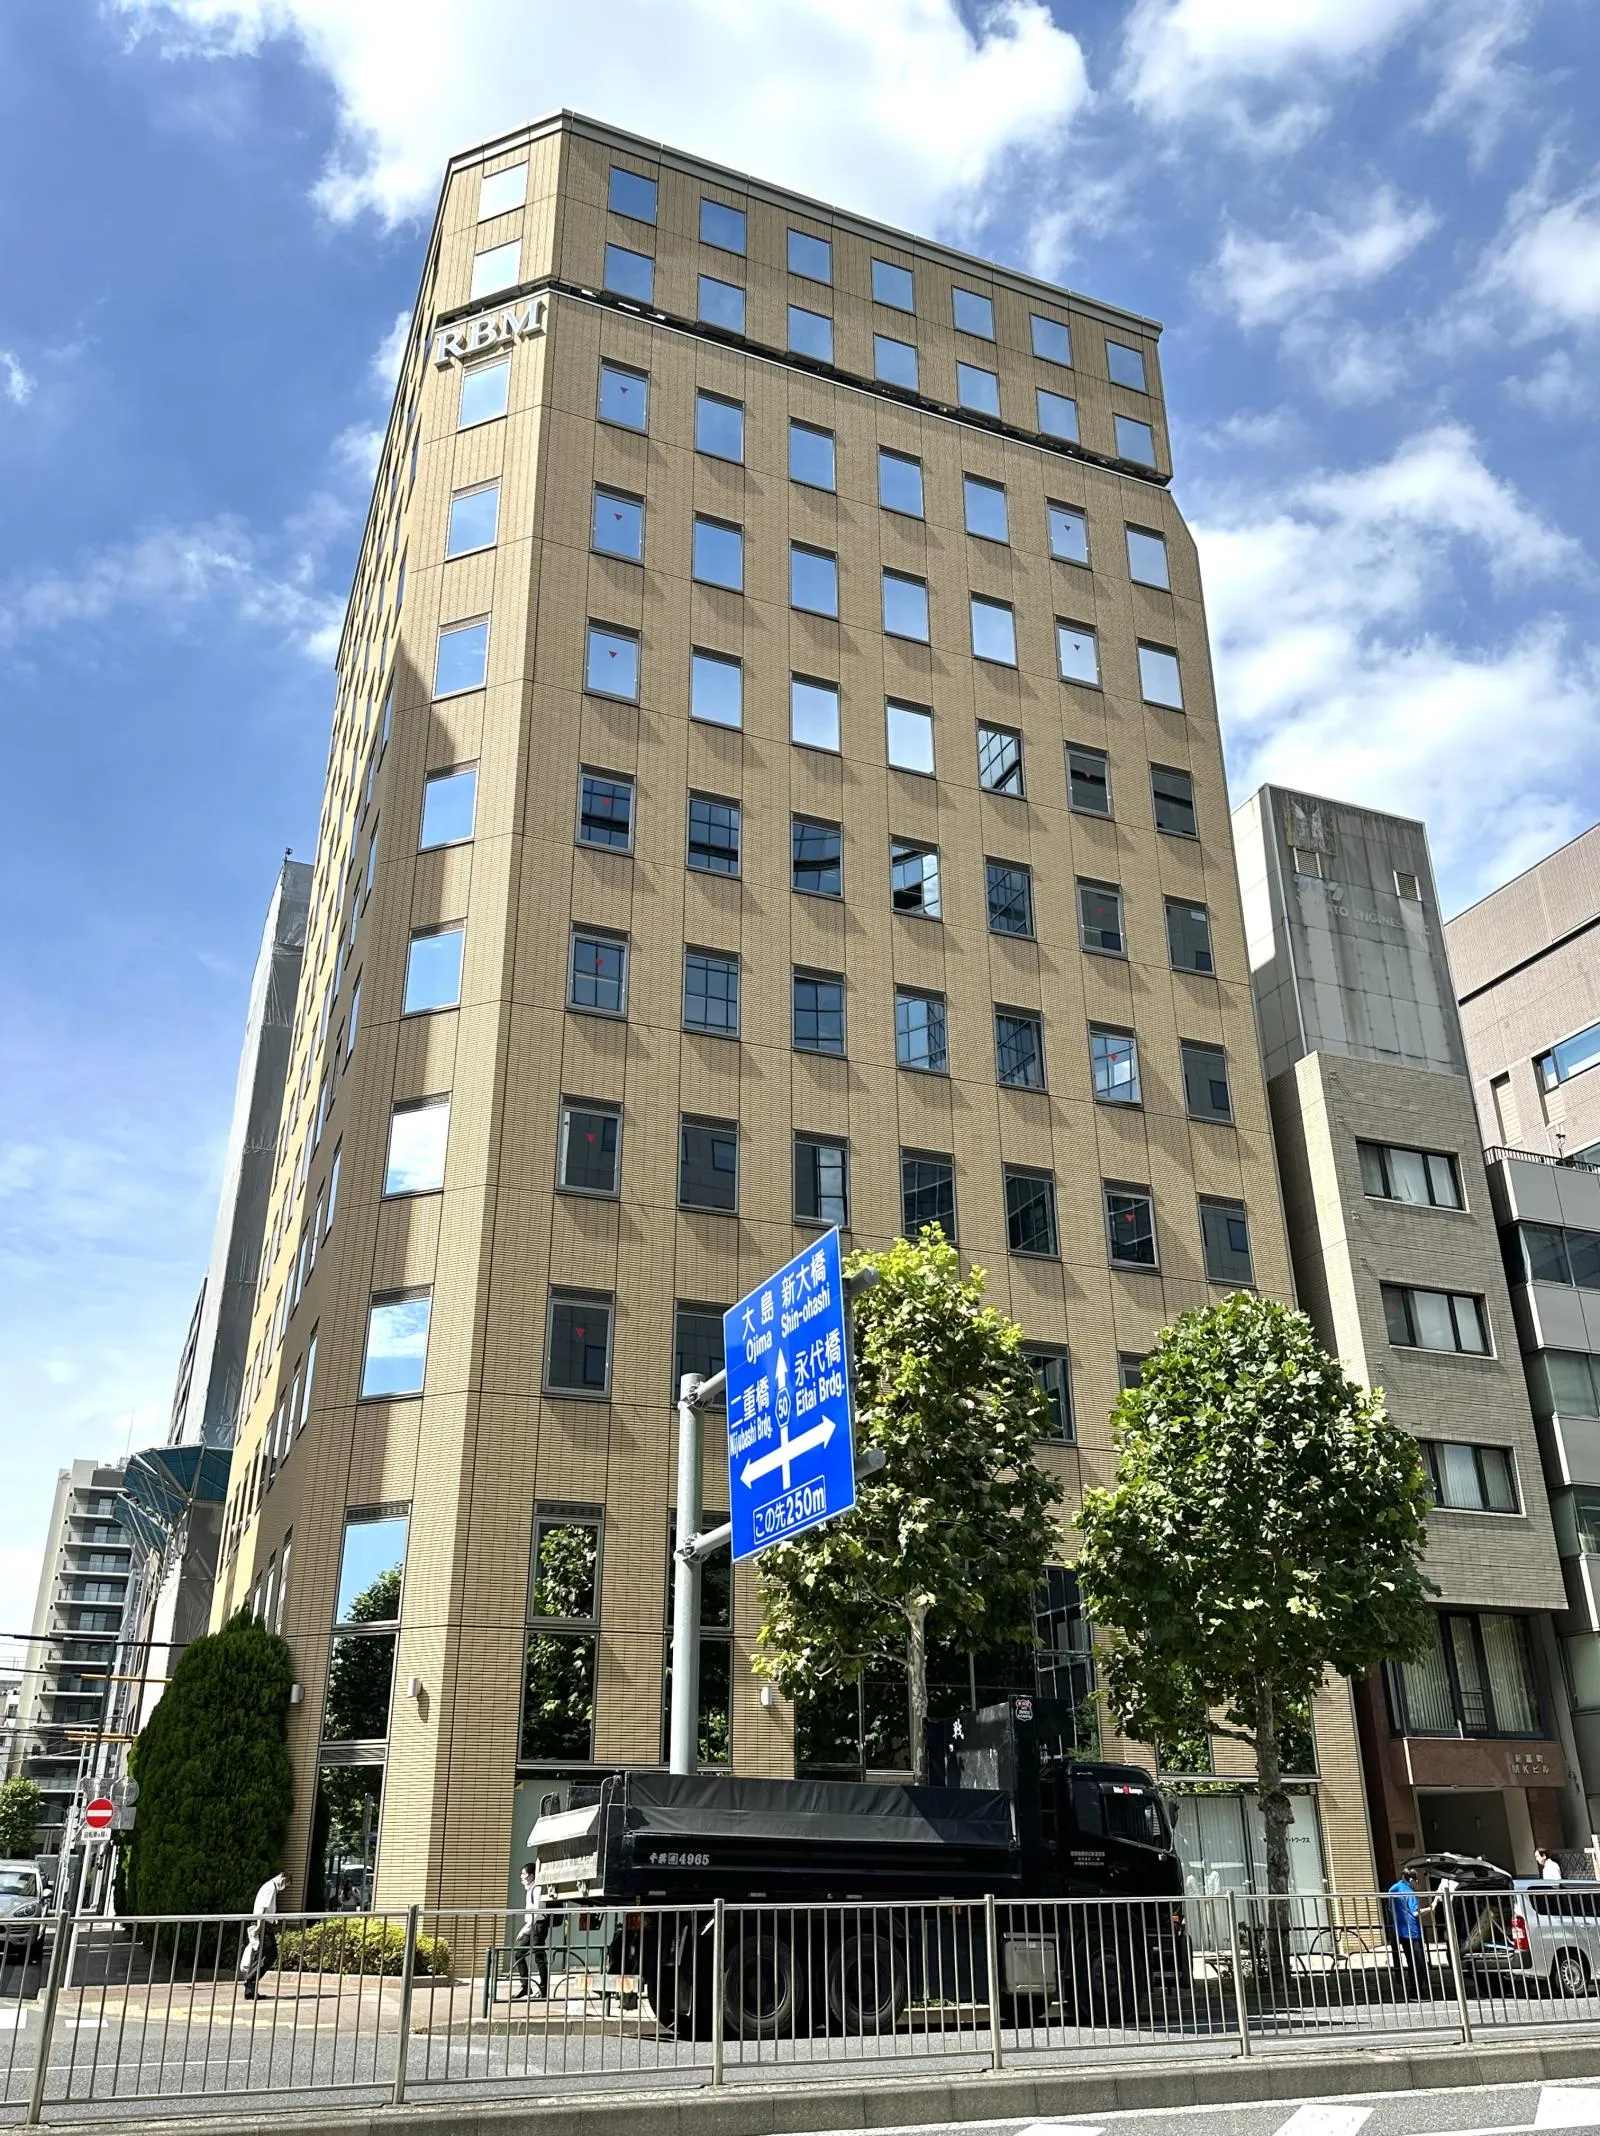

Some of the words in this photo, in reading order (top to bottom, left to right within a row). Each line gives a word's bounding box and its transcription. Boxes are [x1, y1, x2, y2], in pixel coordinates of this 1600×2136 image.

[434, 300, 542, 366] RBM
[781, 1248, 826, 1309] 新大橋
[742, 1290, 774, 1341] 大島
[781, 1283, 831, 1339] Shin-ohashi
[746, 1331, 773, 1364] Ojima
[794, 1327, 841, 1387] 永代橋
[730, 1375, 770, 1429] 二重橋
[778, 1396, 788, 1419] 50
[795, 1381, 817, 1417] Eitai
[818, 1369, 845, 1403] Brdg.
[730, 1420, 757, 1459] Nijubashi
[757, 1412, 773, 1441] Brdg.
[755, 1486, 825, 1538] この先250m
